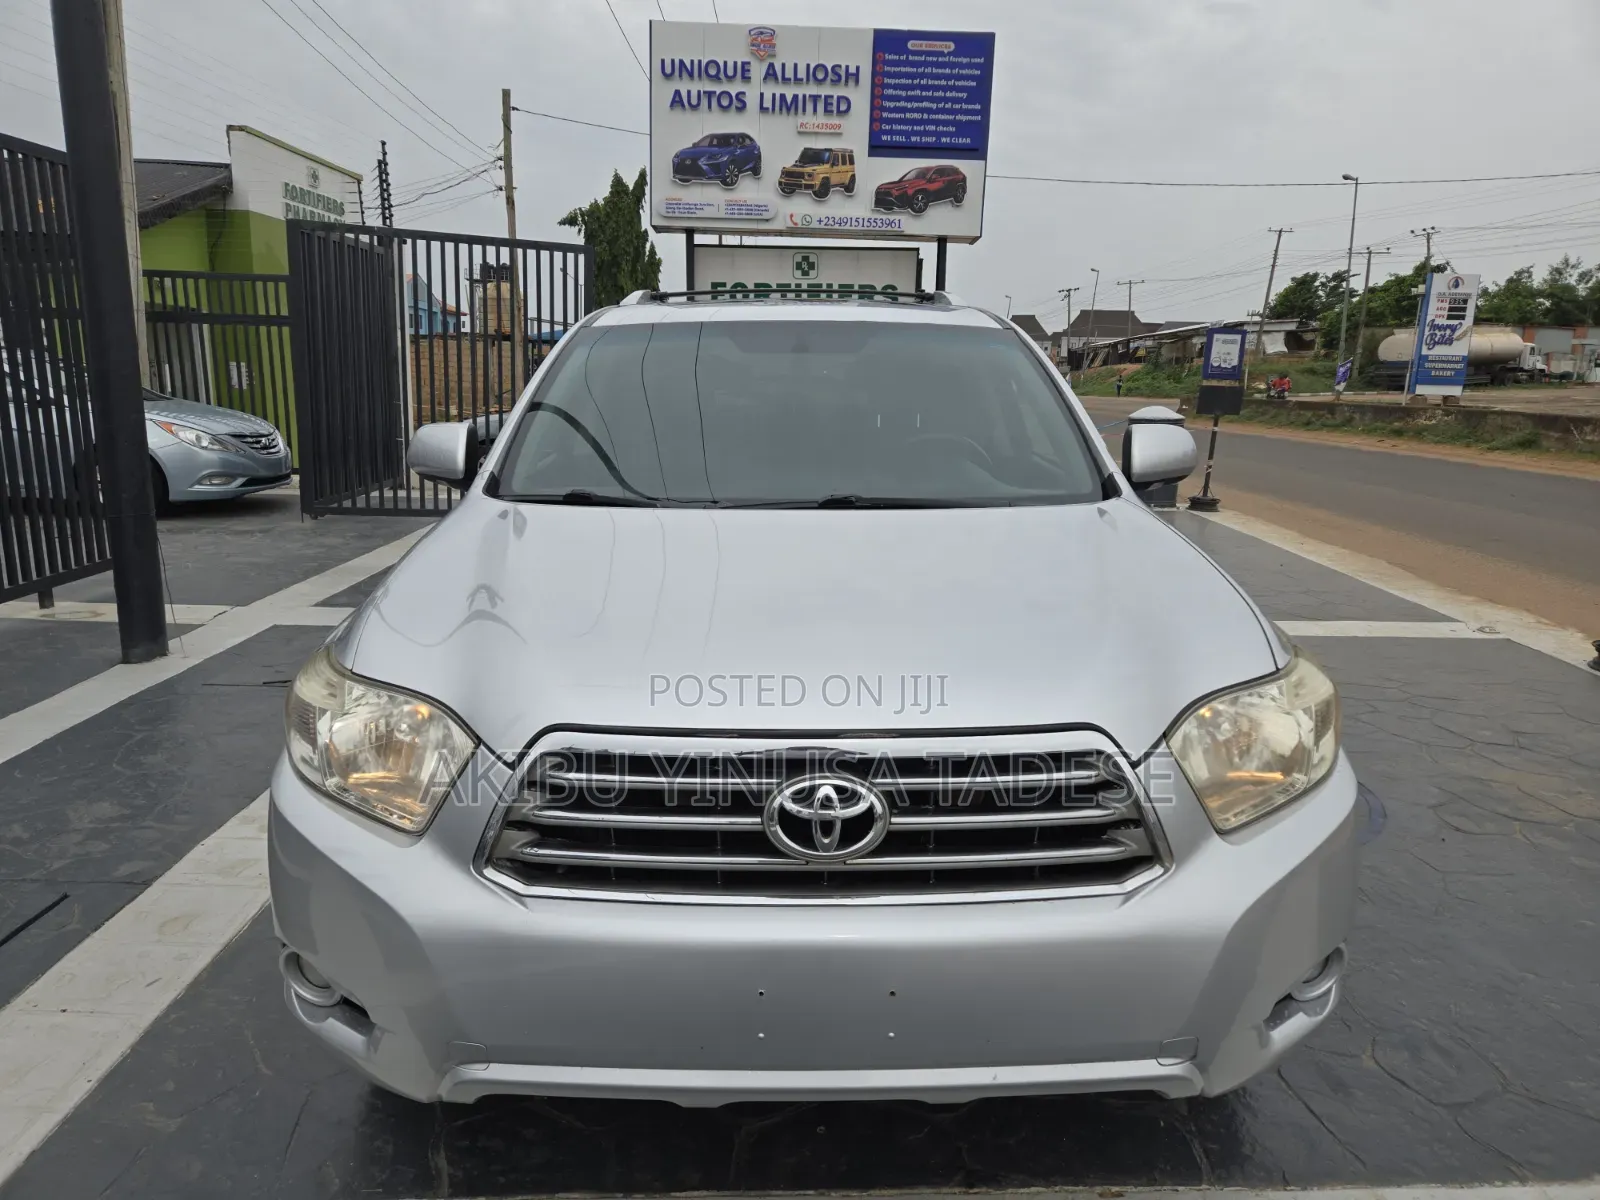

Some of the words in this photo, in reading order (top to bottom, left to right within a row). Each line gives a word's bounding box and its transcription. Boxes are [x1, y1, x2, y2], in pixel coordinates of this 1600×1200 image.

[950, 56, 970, 64] foreign
[660, 58, 752, 82] UNIQUE
[762, 61, 861, 86] ALLIOSH
[885, 66, 916, 74] Importation
[669, 89, 748, 112] AUTOS
[759, 92, 852, 116] LIMITED
[800, 121, 842, 130] RC:1435009
[284, 182, 346, 218] FORTIFIERS
[284, 202, 346, 224] PHARMA
[816, 216, 902, 229] +2349151553961
[1427, 319, 1462, 337] Ivory
[1425, 332, 1454, 350] Bites
